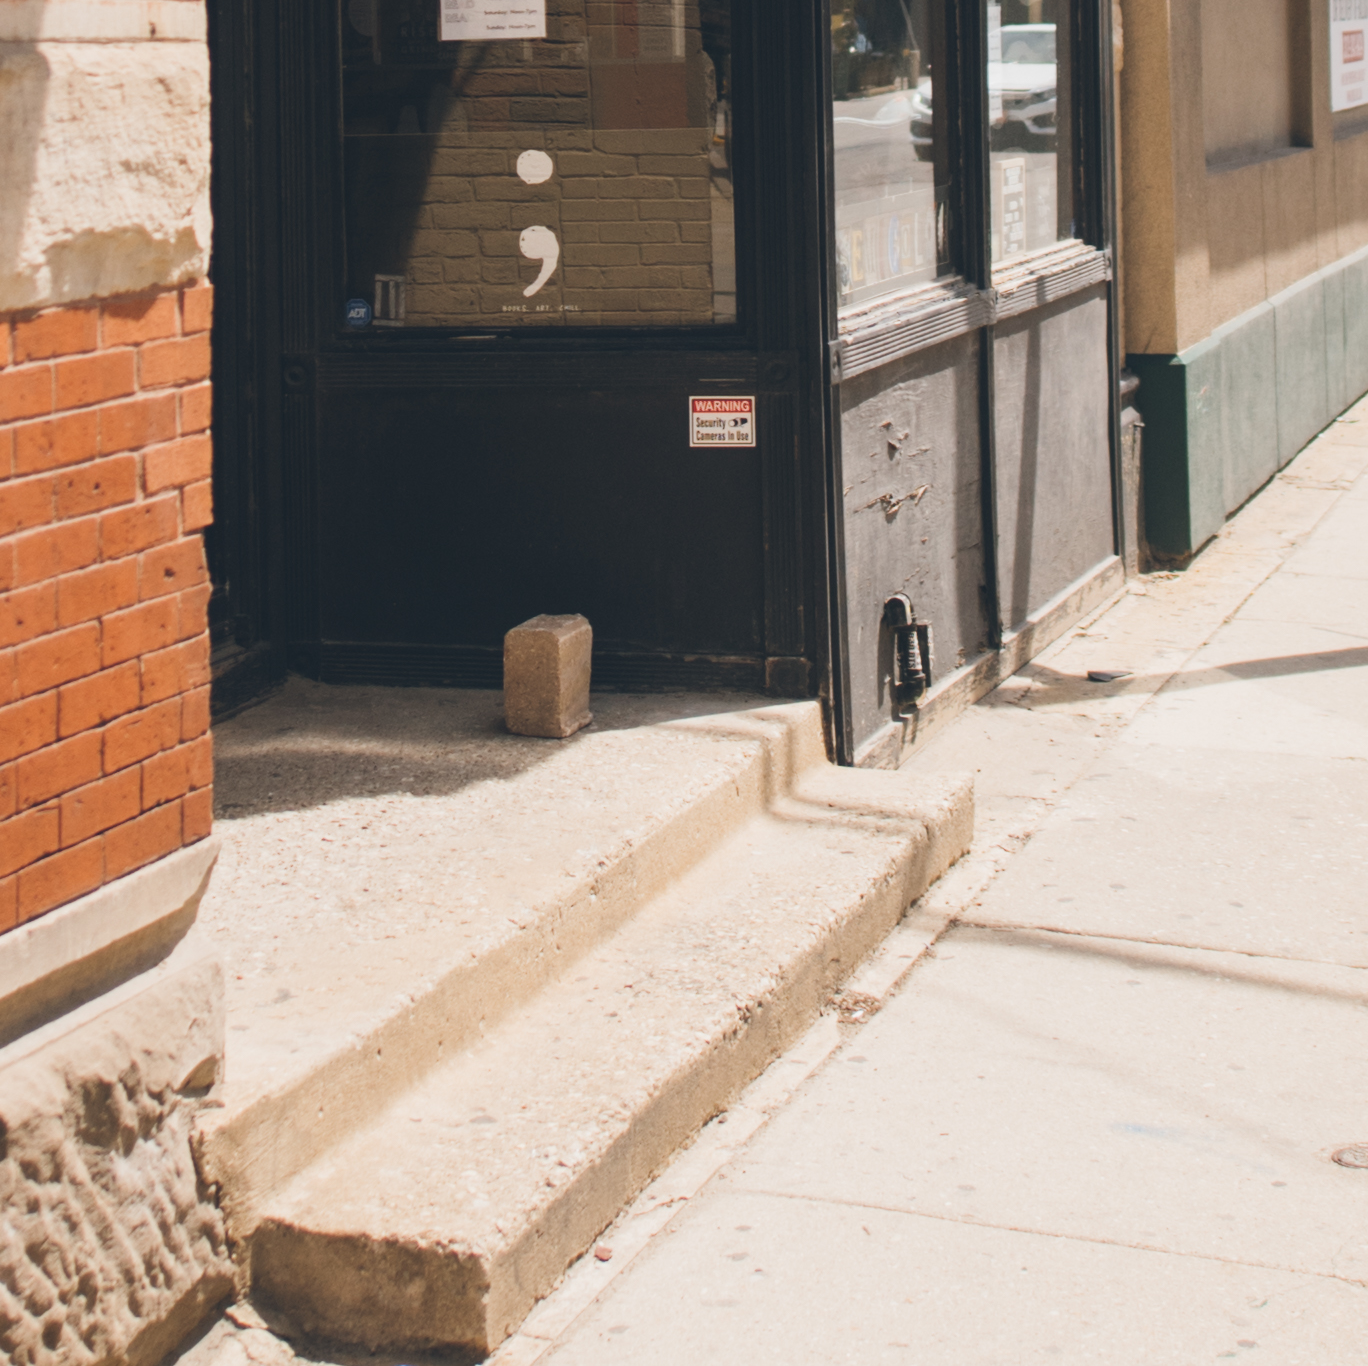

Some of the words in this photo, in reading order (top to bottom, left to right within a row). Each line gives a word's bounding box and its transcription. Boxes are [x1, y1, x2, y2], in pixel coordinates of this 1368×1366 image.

[348, 308, 367, 318] ADT
[695, 400, 750, 412] WARNING
[696, 417, 726, 430] Security
[696, 430, 726, 441] Cameras
[727, 430, 735, 441] In
[736, 430, 749, 441] Use
